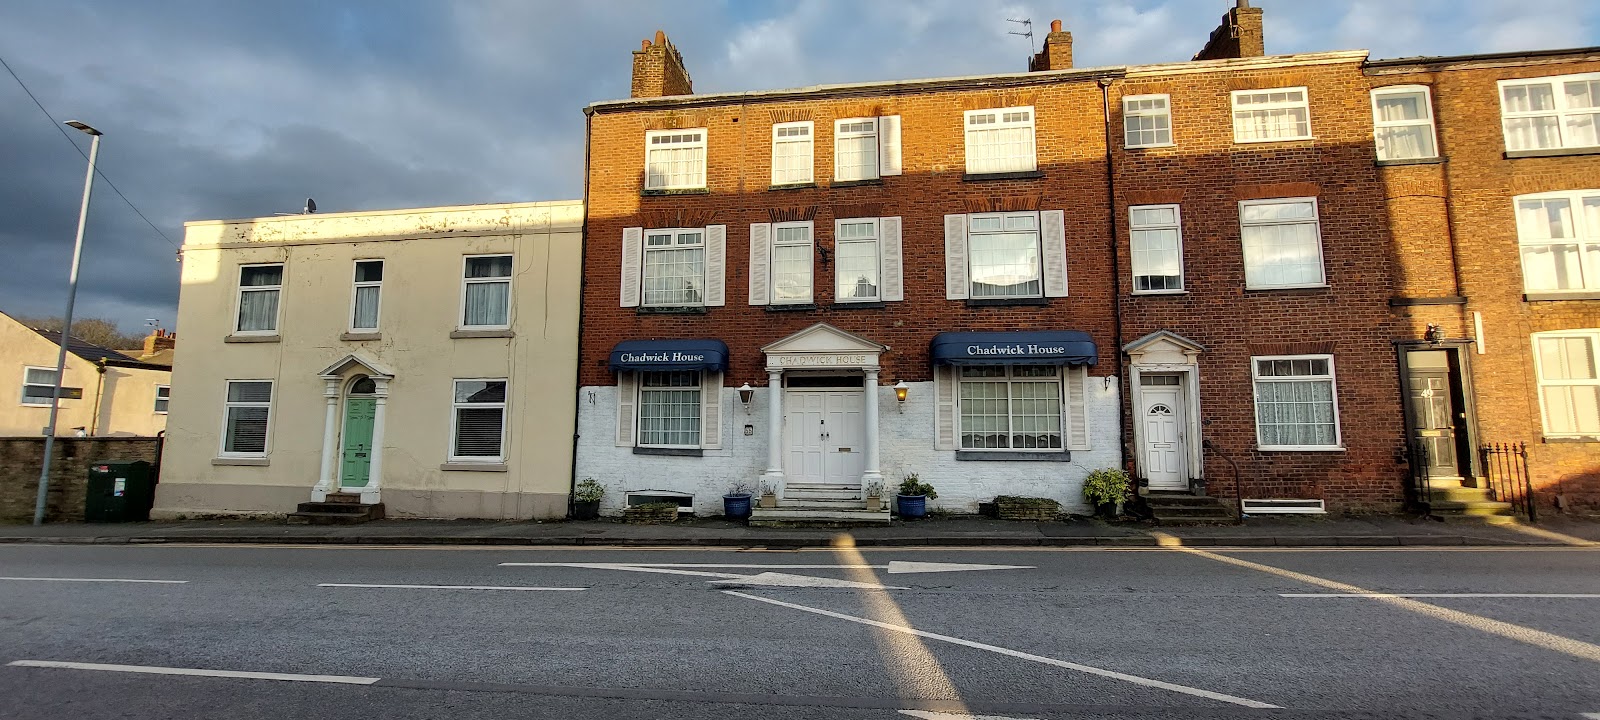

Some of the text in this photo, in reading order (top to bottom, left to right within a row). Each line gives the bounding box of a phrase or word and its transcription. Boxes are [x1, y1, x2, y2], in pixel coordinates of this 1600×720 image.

[967, 344, 1065, 355] Chadwick House
[620, 352, 704, 363] Chadwick House
[780, 355, 866, 366] CHADWICK HOUSE
[1420, 388, 1434, 398] 49
